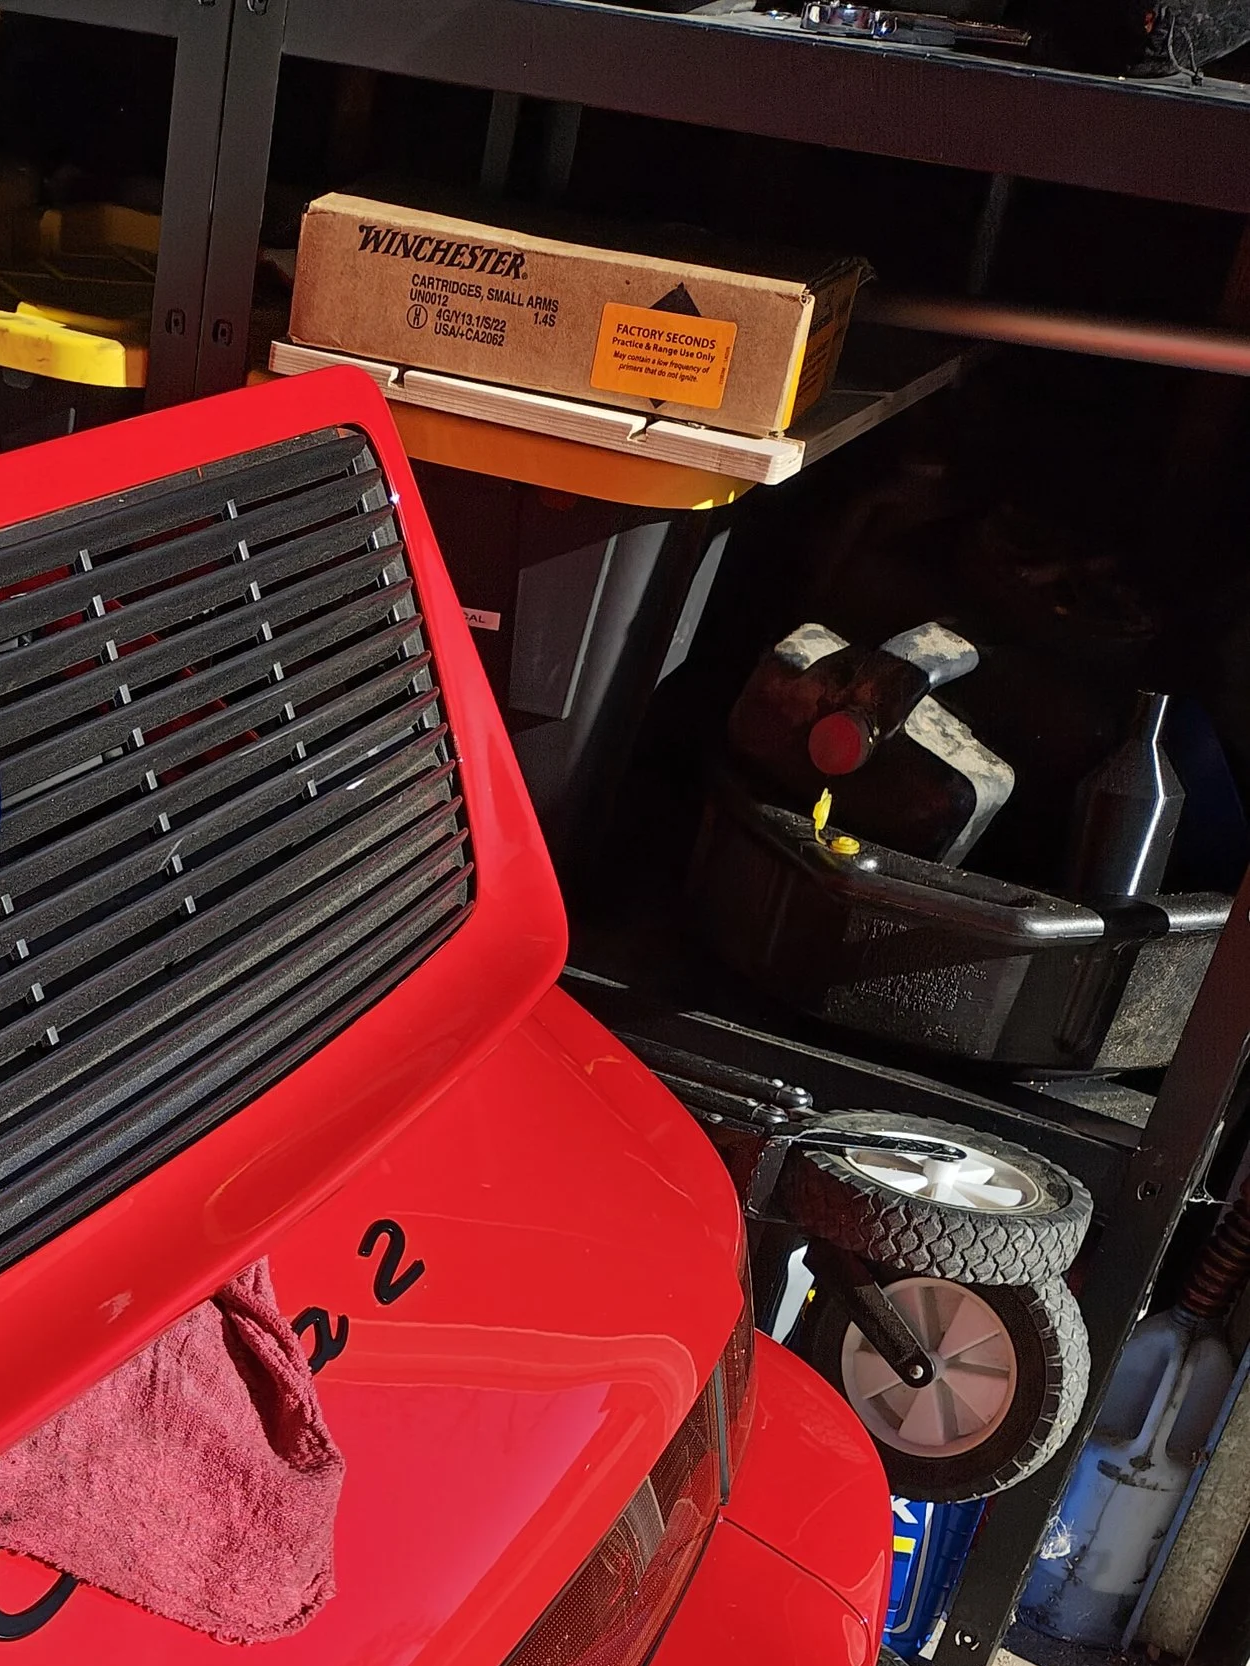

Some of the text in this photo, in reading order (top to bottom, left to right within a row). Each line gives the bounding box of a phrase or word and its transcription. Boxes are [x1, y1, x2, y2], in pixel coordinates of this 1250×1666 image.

[358, 225, 526, 280] WINCHESTER
[411, 274, 559, 313] CARTRIDGES, SMALL ARMS
[410, 288, 556, 328] UN0012 1.4S
[436, 308, 507, 333] 4G/Y13.1/S/22
[434, 322, 505, 347] USA/+CA2062
[616, 323, 716, 350] FACTORY SECONDS
[612, 337, 716, 363] Practice & Range Use Only
[613, 350, 626, 361] May
[627, 354, 651, 363] contain
[657, 358, 668, 366] low
[670, 360, 701, 374] frequency
[618, 363, 643, 373] primers
[644, 366, 657, 375] that
[667, 371, 678, 379] not
